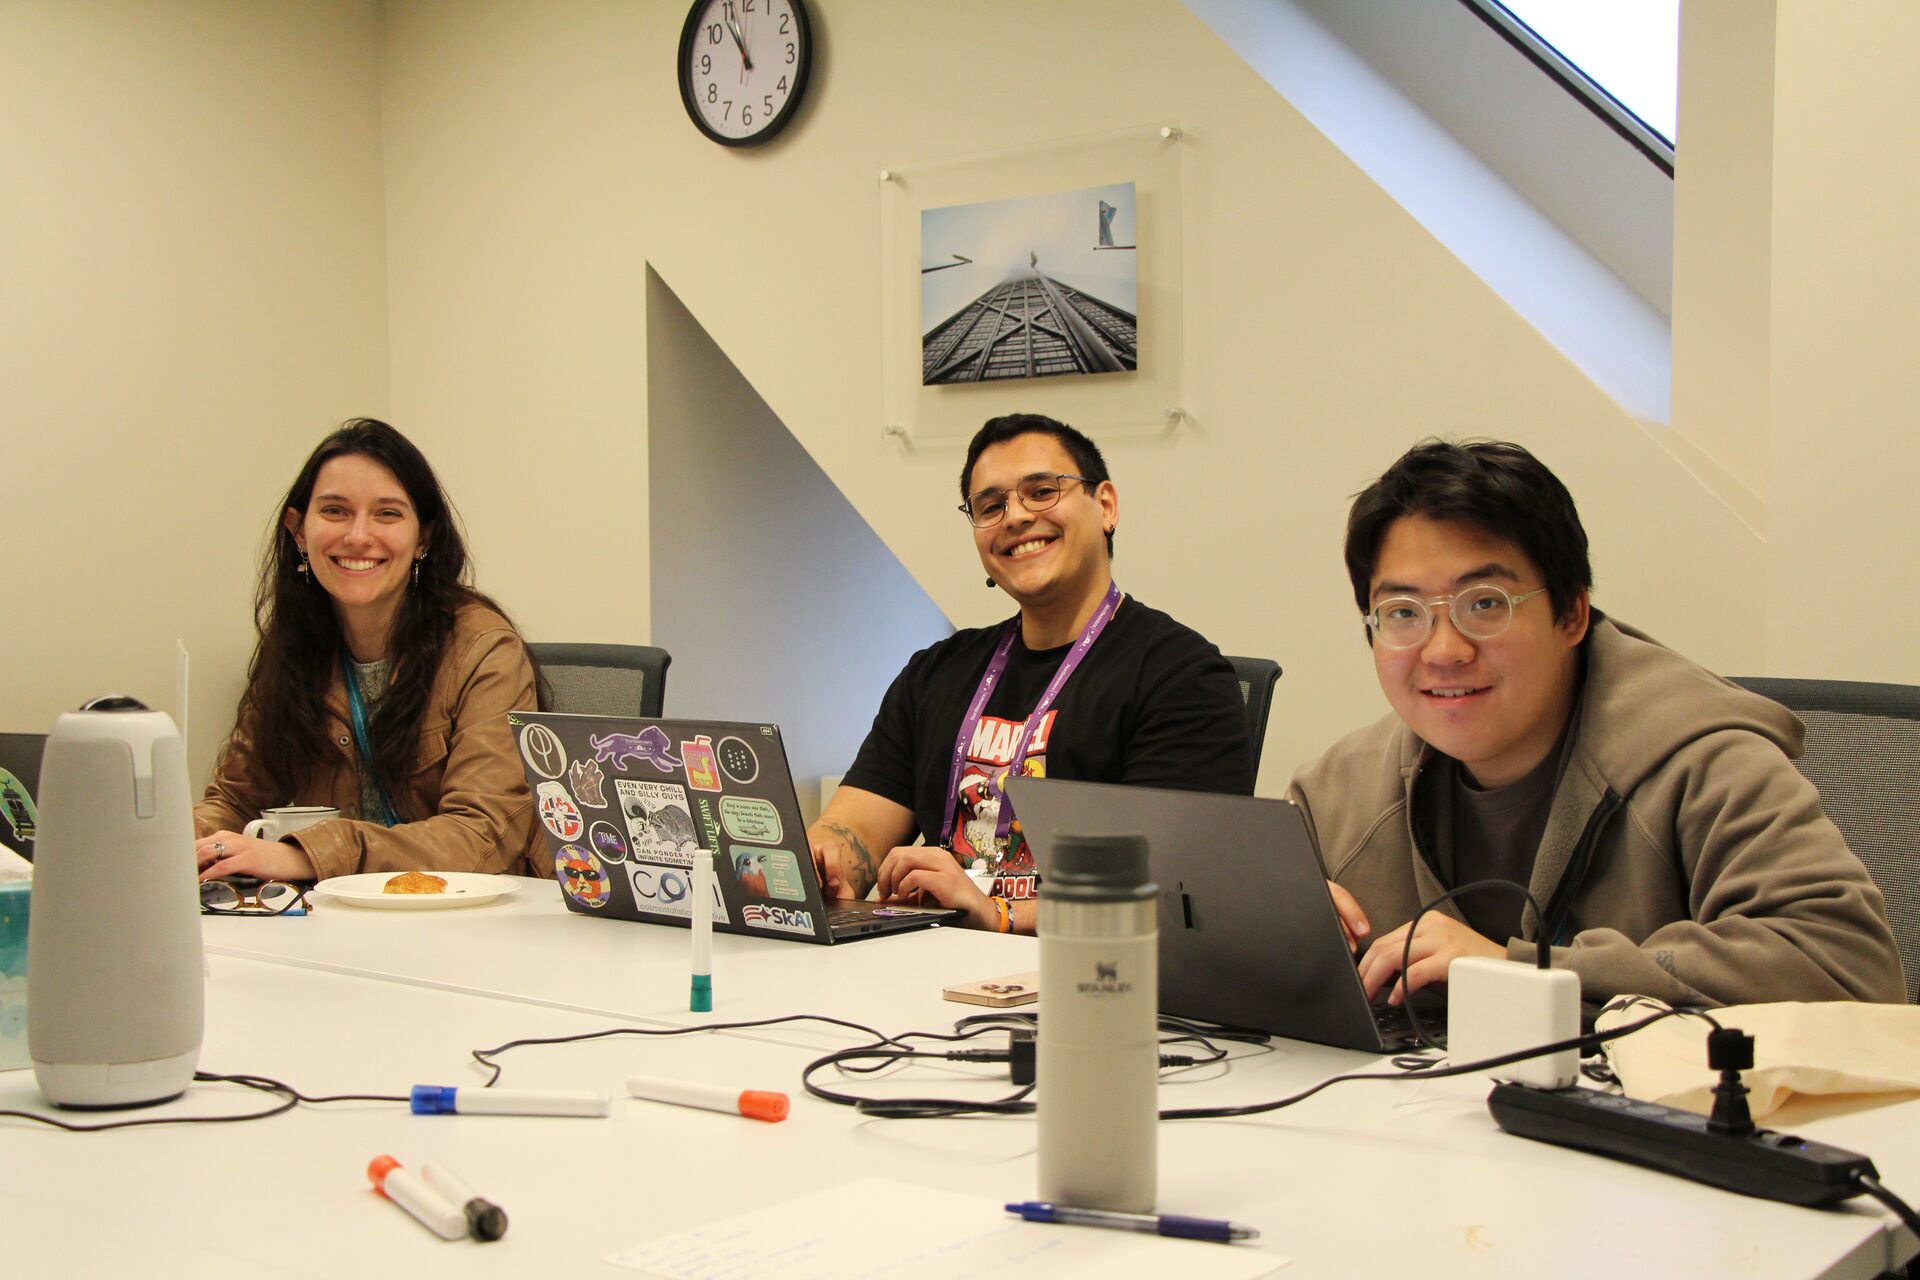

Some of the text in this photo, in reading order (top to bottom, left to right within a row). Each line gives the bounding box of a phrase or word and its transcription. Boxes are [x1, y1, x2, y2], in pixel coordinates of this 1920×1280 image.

[706, 23, 723, 45] 10
[779, 13, 790, 35] 2
[785, 42, 795, 64] 3
[701, 54, 711, 75] 9
[707, 83, 718, 103] 8
[776, 75, 788, 95] 4
[722, 100, 733, 121] 7
[742, 105, 752, 126] 6
[763, 95, 773, 117] 5
[966, 713, 1045, 763] MARL
[617, 781, 684, 793] EVEN VERY CHILL
[638, 790, 659, 799] SILLY
[662, 792, 685, 801] GUYS
[636, 847, 695, 860] CAN PONDER TH
[637, 854, 694, 866] INFINITE SOMETIM
[1077, 982, 1134, 993] STANLEY
